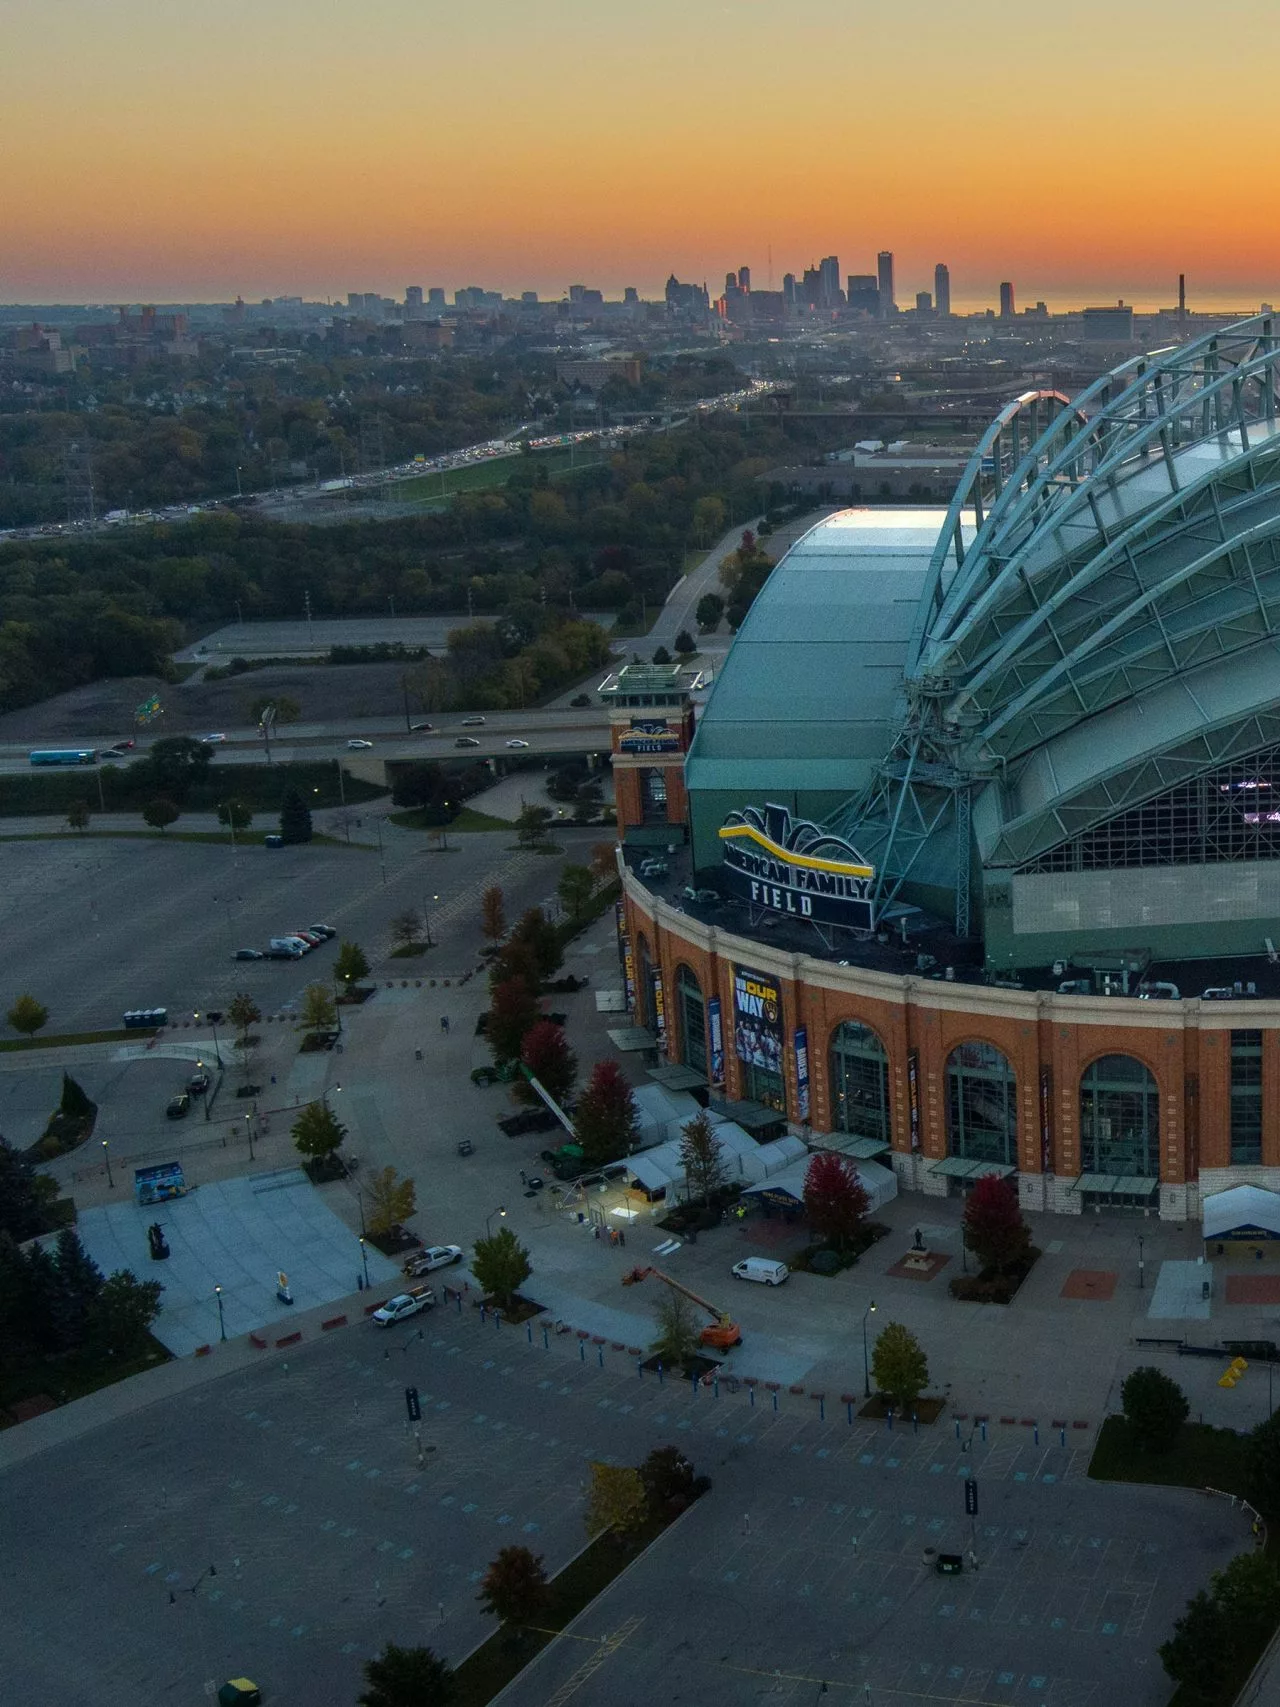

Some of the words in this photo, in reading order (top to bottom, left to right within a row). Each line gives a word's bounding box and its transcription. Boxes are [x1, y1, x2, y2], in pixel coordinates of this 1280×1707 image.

[796, 867, 873, 900] FAMILY
[751, 881, 812, 917] FIELD
[736, 990, 765, 1018] WAY
[746, 981, 777, 1003] OUR
